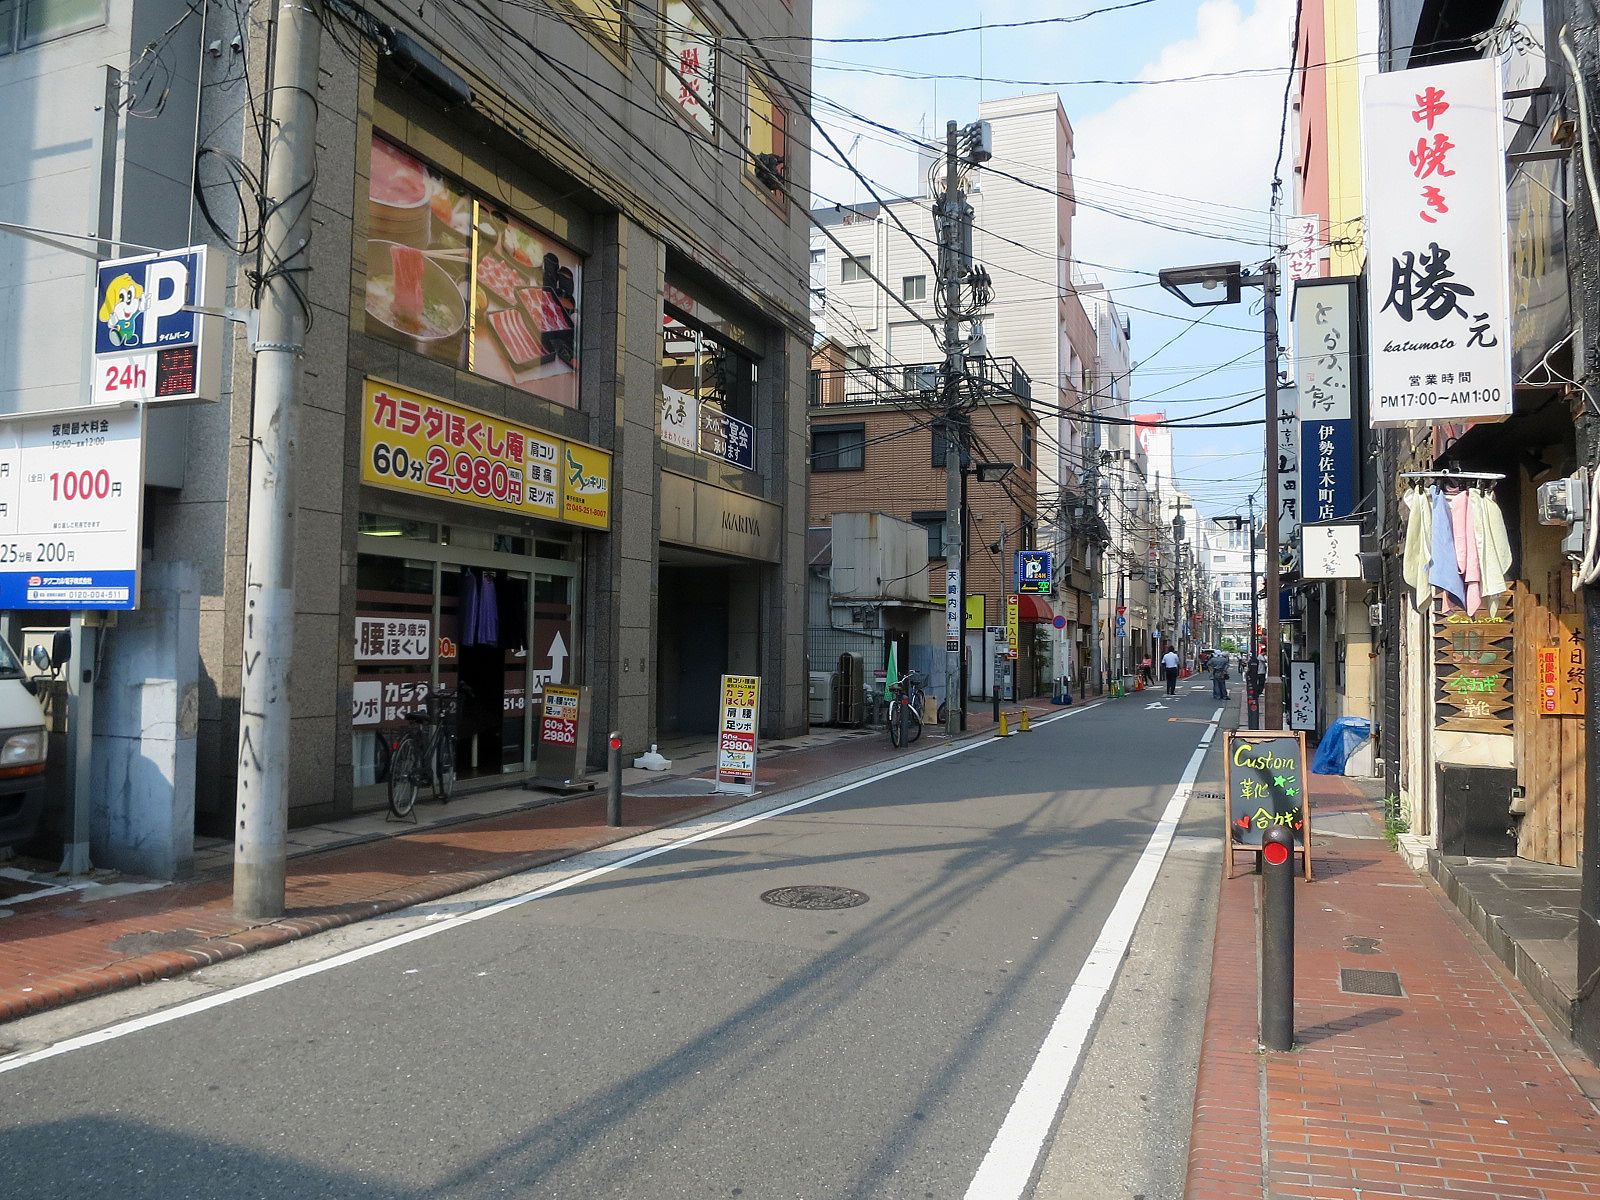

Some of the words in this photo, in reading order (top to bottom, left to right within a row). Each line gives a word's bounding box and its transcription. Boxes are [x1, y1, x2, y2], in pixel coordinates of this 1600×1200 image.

[1409, 86, 1455, 224] 串焼き
[1303, 222, 1316, 274] カラオケ
[142, 261, 188, 344] P
[1380, 241, 1498, 349] 勝元
[159, 331, 190, 342] タイムパーク
[1382, 338, 1457, 352] katumoto
[105, 363, 147, 392] 24h
[1408, 371, 1472, 388] 営業時間
[52, 420, 109, 437] 夜間最大料金
[373, 392, 525, 464] カラダほぐし庵
[529, 441, 555, 460] 肩コリ
[713, 438, 741, 461] 承ります
[372, 443, 424, 482] 60分
[531, 464, 554, 484] 腰痛
[1318, 424, 1335, 519] 伊勢佐木町店
[528, 486, 555, 505] 足ツボ
[721, 510, 761, 537] MARIYA
[1038, 581, 1049, 592] 空
[387, 622, 426, 636] 全身疲労
[1009, 609, 1017, 646] ここ入口
[387, 639, 427, 656] ほぐし
[1567, 627, 1585, 704] 本日終了
[1450, 674, 1499, 694] 合カギ
[726, 720, 752, 730] 足ツボ
[1233, 744, 1296, 770] Custom
[1251, 806, 1299, 830] 合カギ
